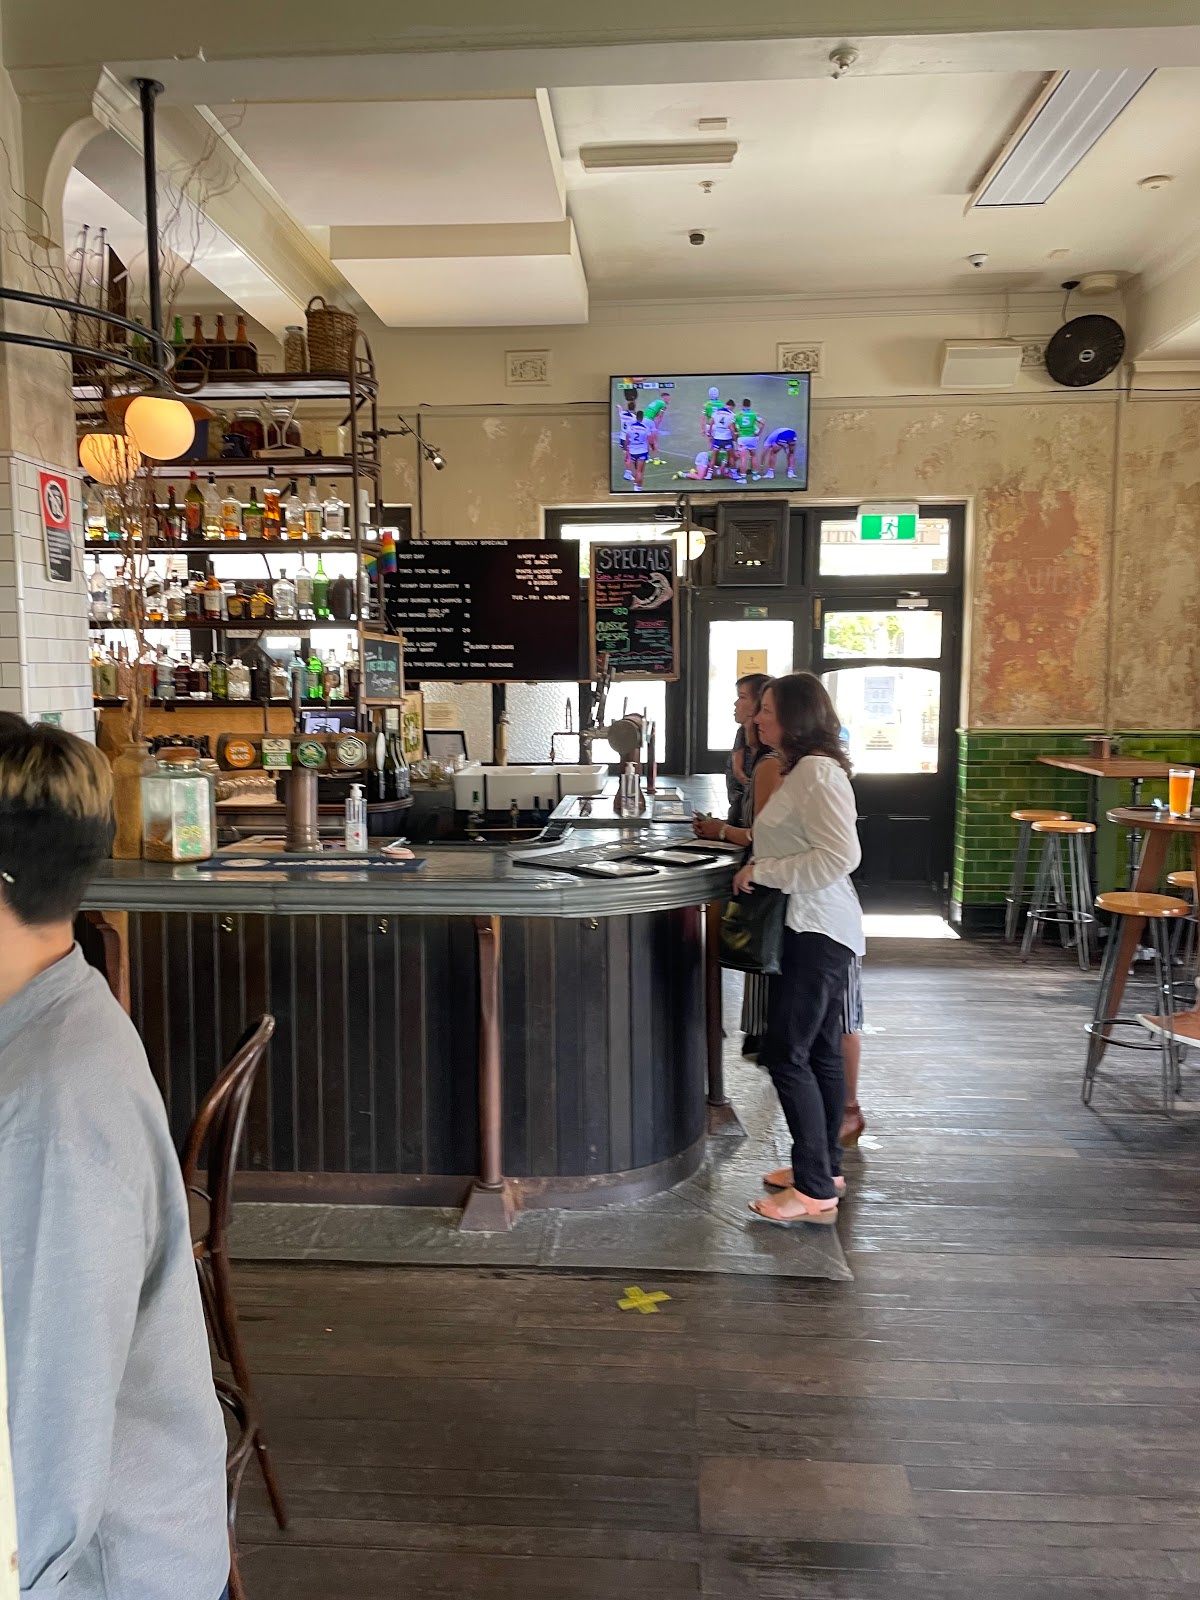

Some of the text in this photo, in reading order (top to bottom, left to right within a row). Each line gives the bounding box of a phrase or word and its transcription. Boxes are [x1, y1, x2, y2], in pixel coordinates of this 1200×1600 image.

[718, 417, 725, 426] 4
[742, 416, 751, 426] 5
[633, 432, 640, 442] 2
[600, 548, 670, 571] SPECIALS
